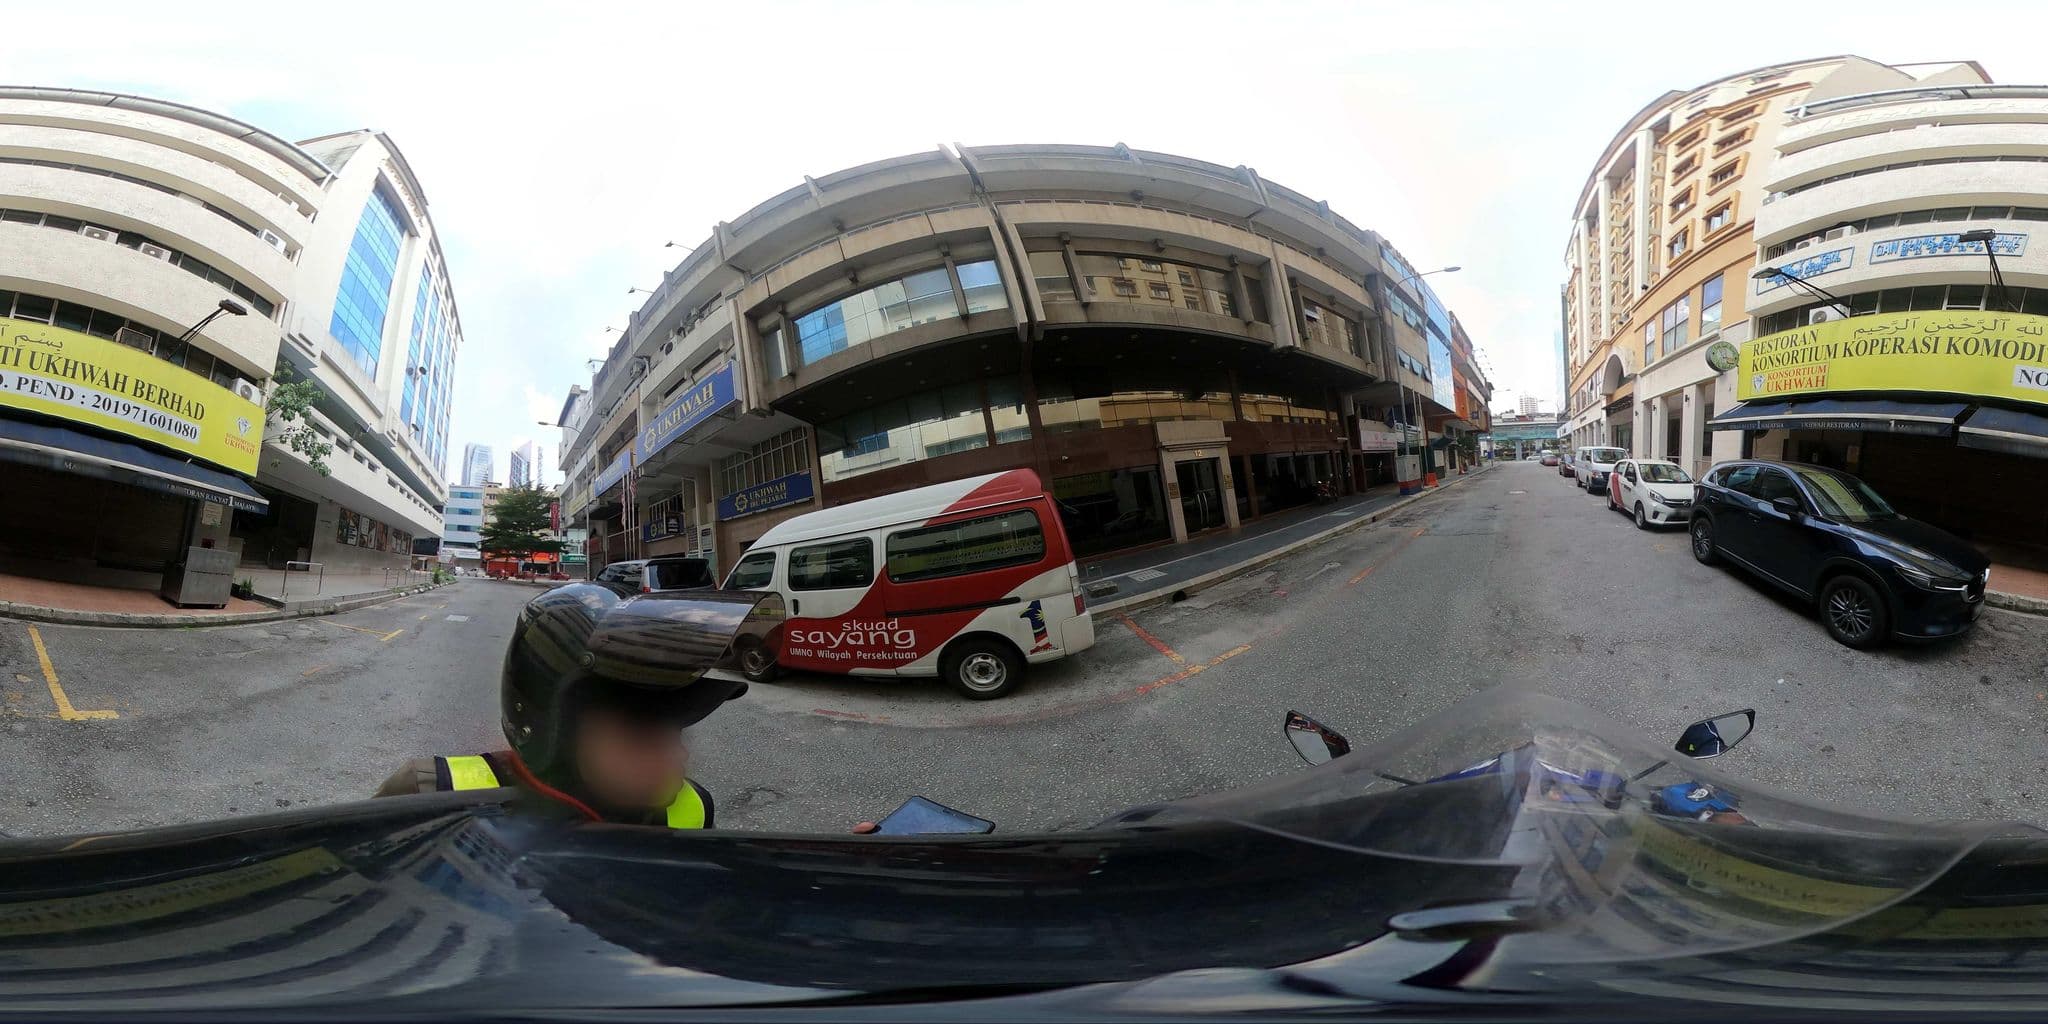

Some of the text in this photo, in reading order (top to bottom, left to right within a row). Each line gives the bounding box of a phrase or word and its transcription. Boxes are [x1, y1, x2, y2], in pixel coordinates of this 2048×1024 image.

[1753, 328, 1819, 357] RESTORAN
[1752, 343, 1839, 372] KONSORTIUM
[1842, 335, 1940, 358] KOPERASI
[1767, 364, 1828, 381] KONSORTIUM
[29, 350, 129, 394] UKHWAH
[132, 378, 205, 421] BERHAD
[1766, 375, 1826, 393] UKHWAH
[16, 376, 75, 401] PEND
[91, 394, 198, 440] 201971601080
[657, 382, 714, 435] UKHWAH
[749, 481, 787, 500] UKHWAH
[842, 618, 899, 631] skuad
[790, 629, 916, 649] sayang
[789, 648, 917, 660] UMNO Wilayah Persekutuan
